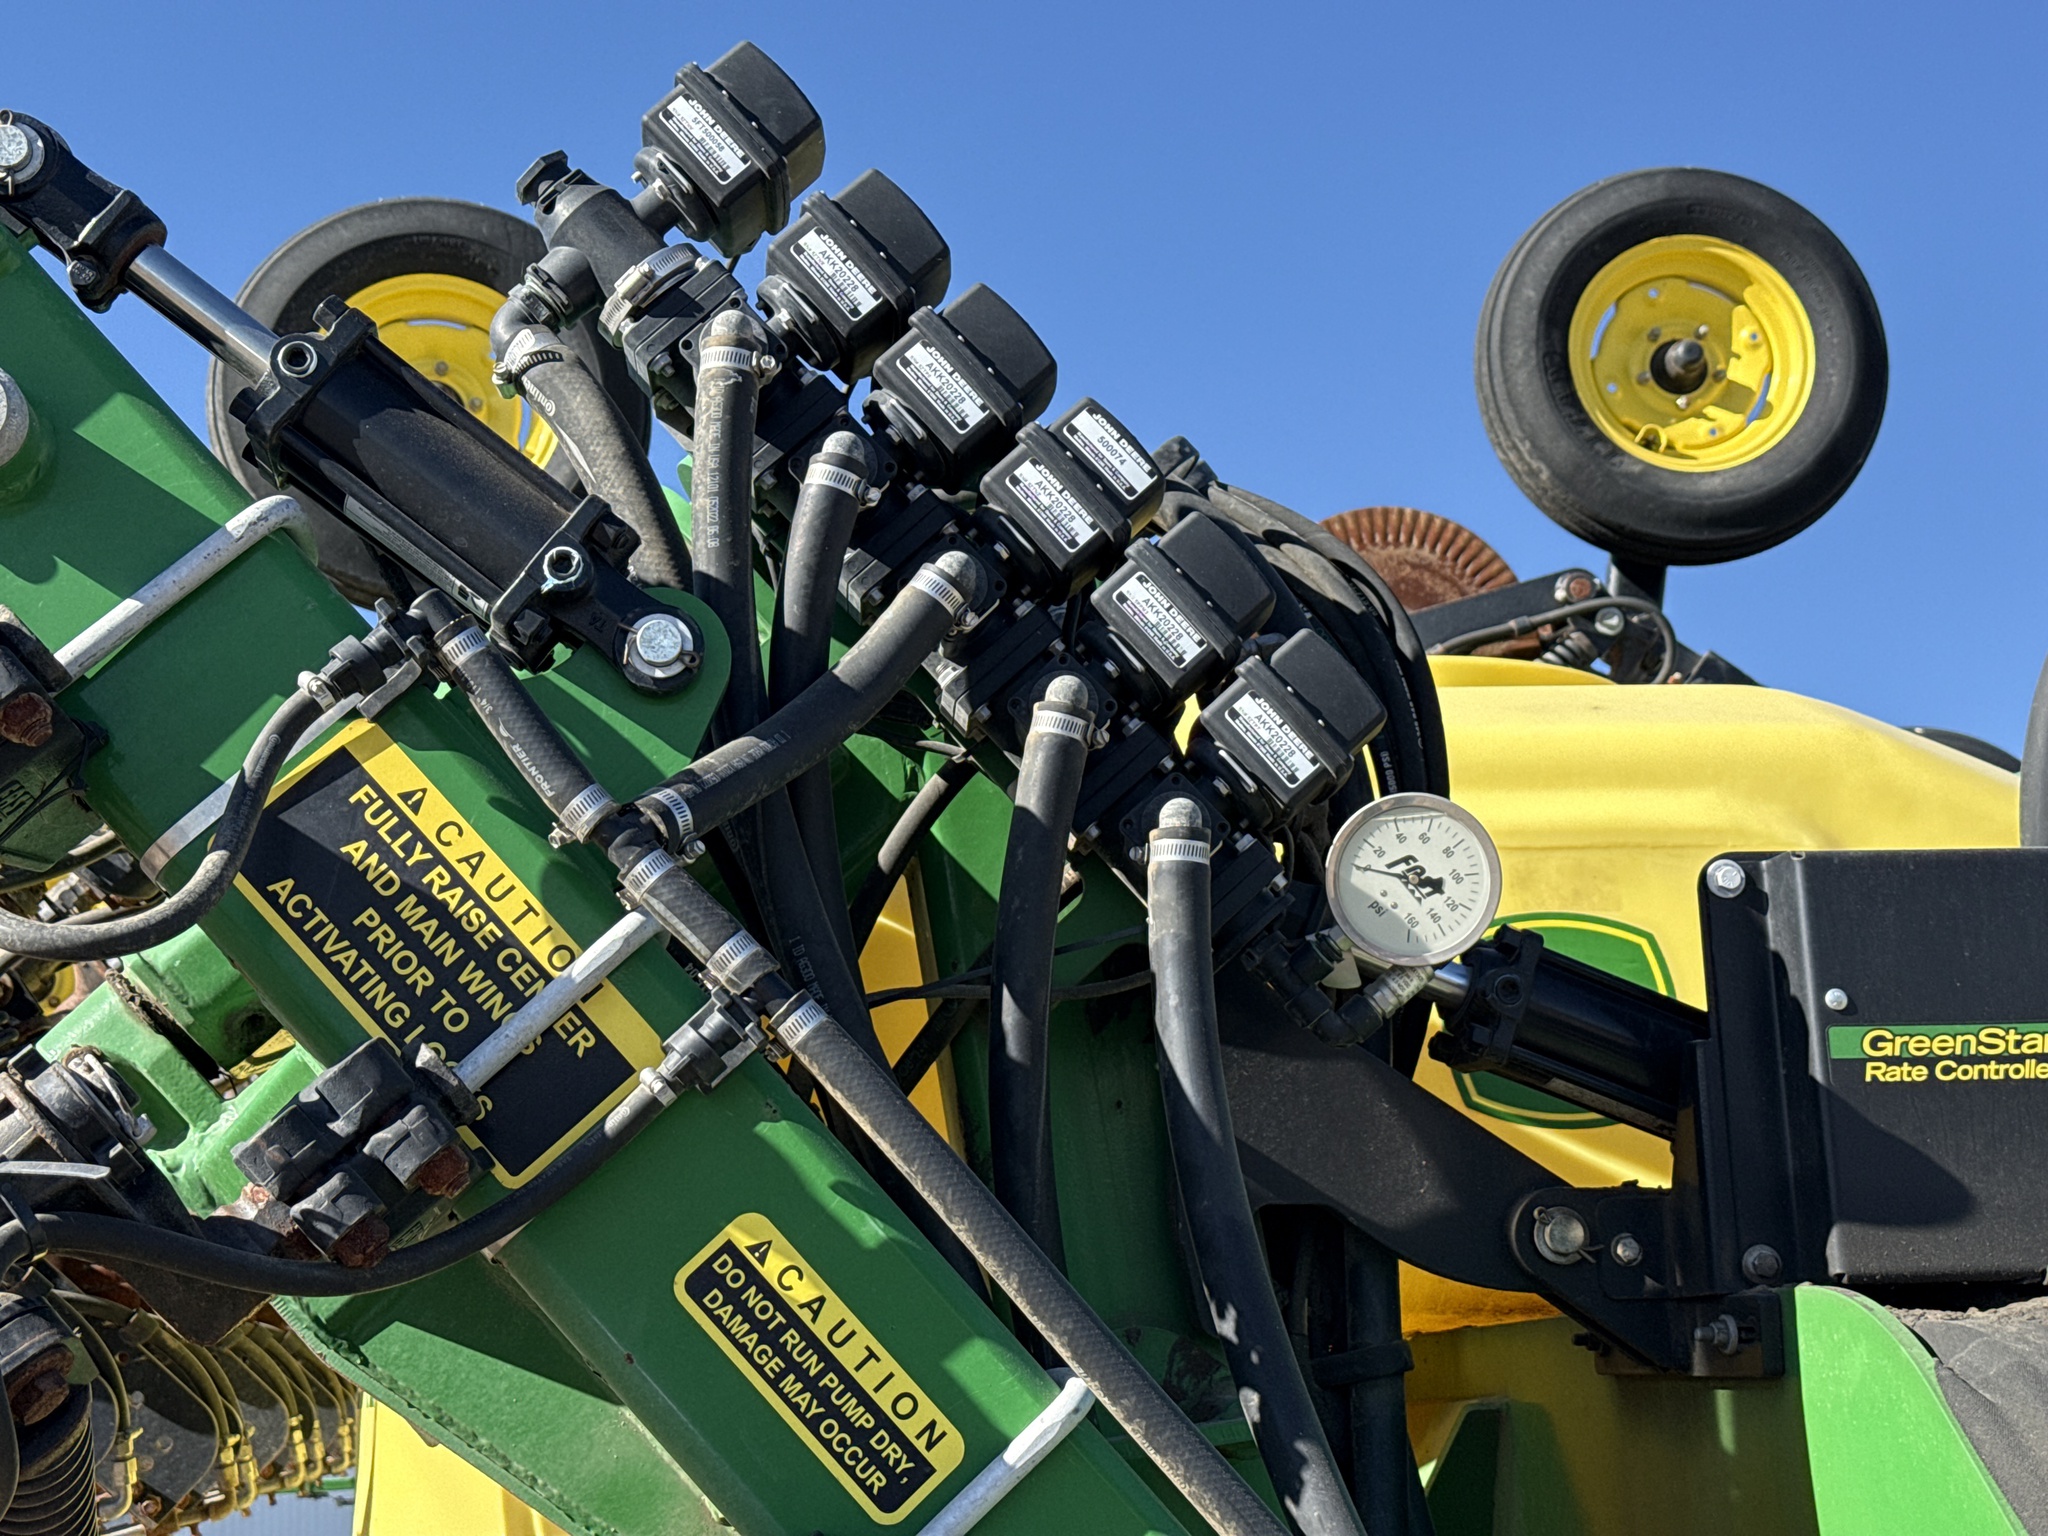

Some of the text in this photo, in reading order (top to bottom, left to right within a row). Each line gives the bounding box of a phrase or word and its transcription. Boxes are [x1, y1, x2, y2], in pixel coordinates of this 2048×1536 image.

[687, 96, 715, 126] JOHN
[712, 123, 745, 158] DEERE
[691, 116, 725, 152] 5FT500058
[818, 247, 859, 292] AKK20228
[819, 231, 847, 261] JOHN
[843, 259, 877, 295] DEERE
[925, 343, 954, 374] JOHN
[950, 371, 984, 407] DEERE
[925, 360, 966, 405] AKK20228
[1091, 410, 1120, 440] JOHN
[1118, 437, 1151, 473] DEERE
[1096, 434, 1127, 466] 500074
[1034, 461, 1063, 492] JOHN
[1060, 489, 1094, 525] DEERE
[1034, 478, 1076, 523] AKK20228
[1141, 578, 1171, 609] JOHN
[1167, 606, 1202, 642] DEERE
[1141, 596, 1184, 641] AKK20228
[1253, 712, 1296, 758] AKK20228
[1254, 694, 1283, 726] JOHN
[1280, 723, 1314, 760] DEERE
[510, 741, 556, 797] FRONTIER
[1373, 846, 1386, 858] 20
[1395, 832, 1407, 844] 40
[1418, 833, 1431, 844] 60
[1442, 846, 1454, 859] 80
[1449, 869, 1464, 885] 100
[346, 782, 434, 874] FULLY
[419, 863, 504, 952] RAISE
[490, 942, 601, 1059] CENER
[1368, 900, 1388, 917] psi
[1404, 913, 1419, 928] 160
[1426, 908, 1442, 924] 140
[1444, 896, 1459, 912] 120
[264, 869, 422, 1039] ACTIVATING
[338, 831, 405, 901] AND
[392, 891, 466, 969] MAIN
[453, 960, 546, 1058] WINS
[350, 905, 438, 998] PRIOR
[425, 987, 474, 1037] TO
[1864, 1060, 1929, 1082] Rate
[710, 1251, 920, 1485] DO NOT RUN PUMP DRY,
[772, 1260, 949, 1453] CAUTION
[701, 1287, 890, 1496] DAMAGE MAY OCCUR
